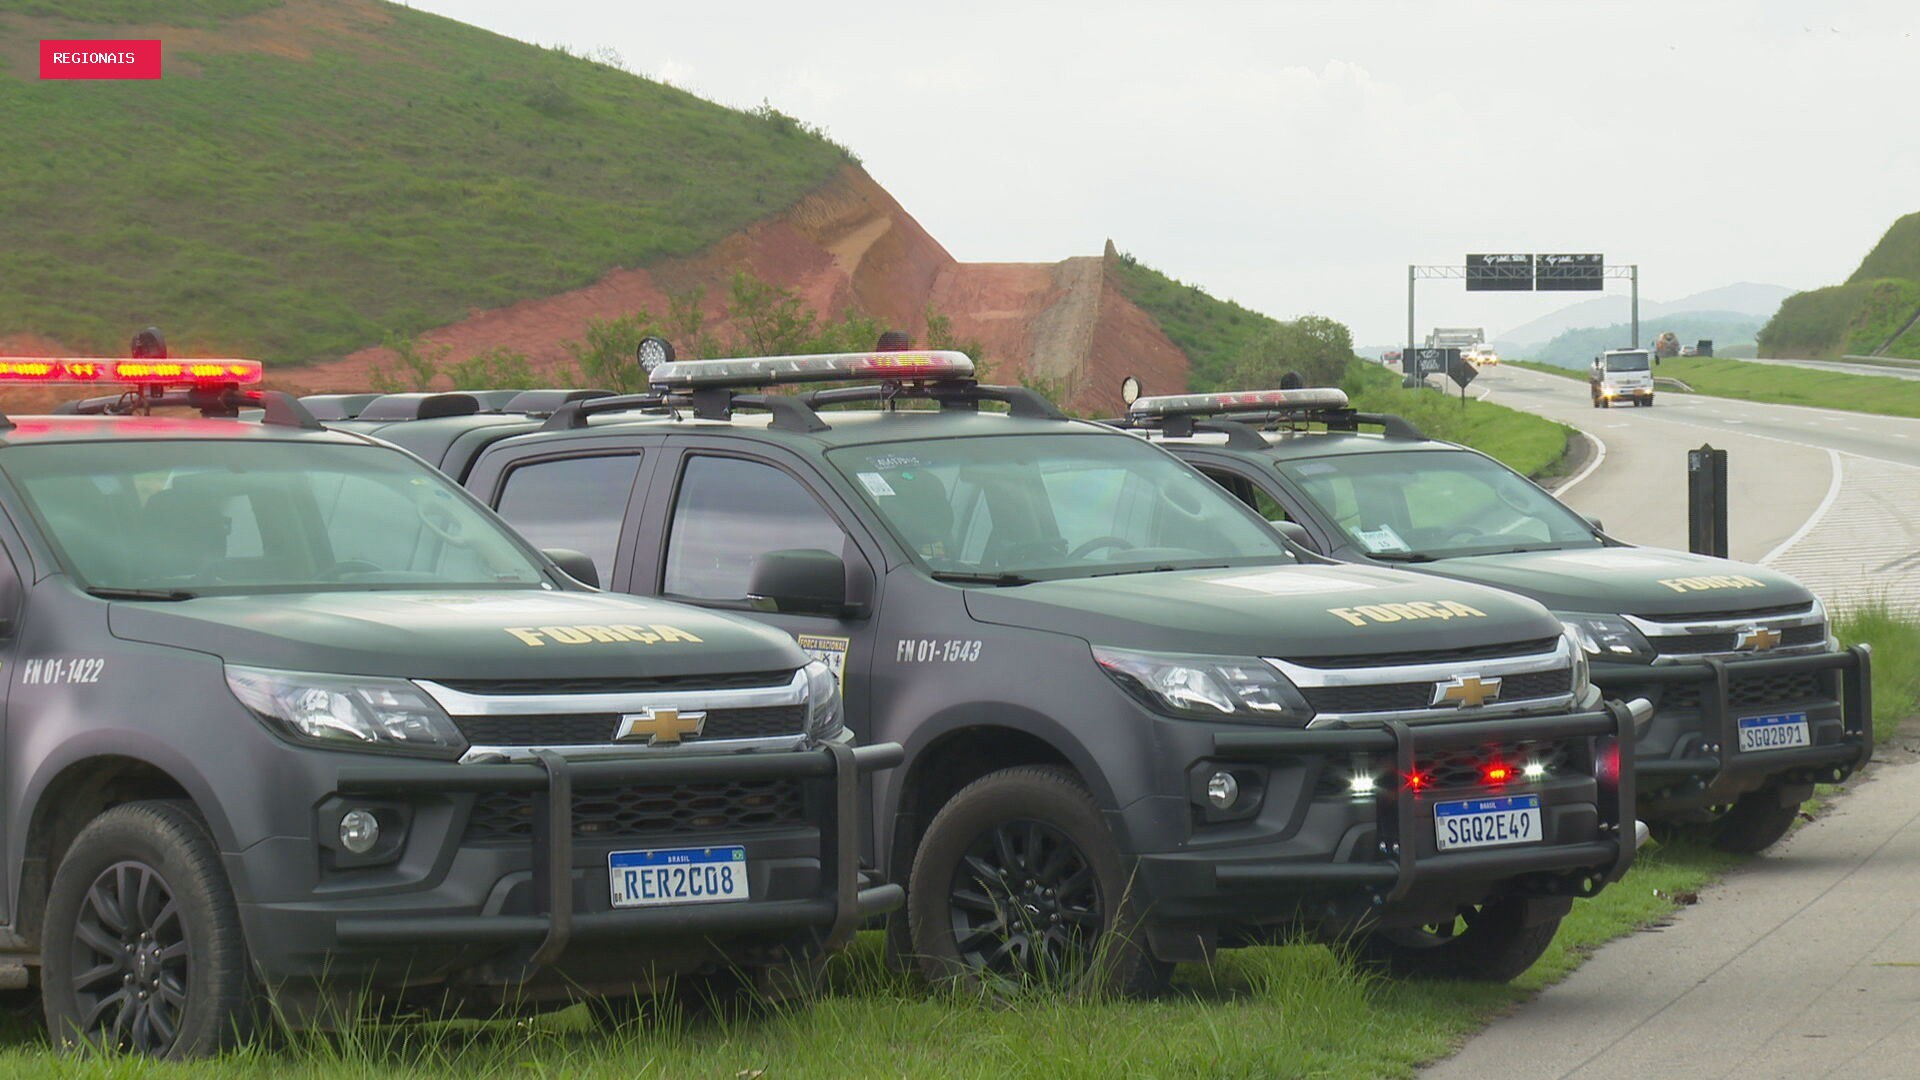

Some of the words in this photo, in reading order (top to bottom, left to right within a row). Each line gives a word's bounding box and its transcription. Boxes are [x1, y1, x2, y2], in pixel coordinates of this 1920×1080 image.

[1656, 575, 1766, 593] FORÇA
[1327, 600, 1488, 627] FORÇA
[503, 624, 704, 646] FORÇA
[818, 640, 845, 651] NACIONAL
[897, 640, 914, 662] FN
[917, 640, 982, 662] 01-1543
[23, 659, 42, 684] FN
[44, 659, 104, 684] 01-1422
[1746, 725, 1802, 748] SGQ2B91
[1447, 812, 1531, 844] SGQ2E49
[624, 866, 734, 900] RER2C08
